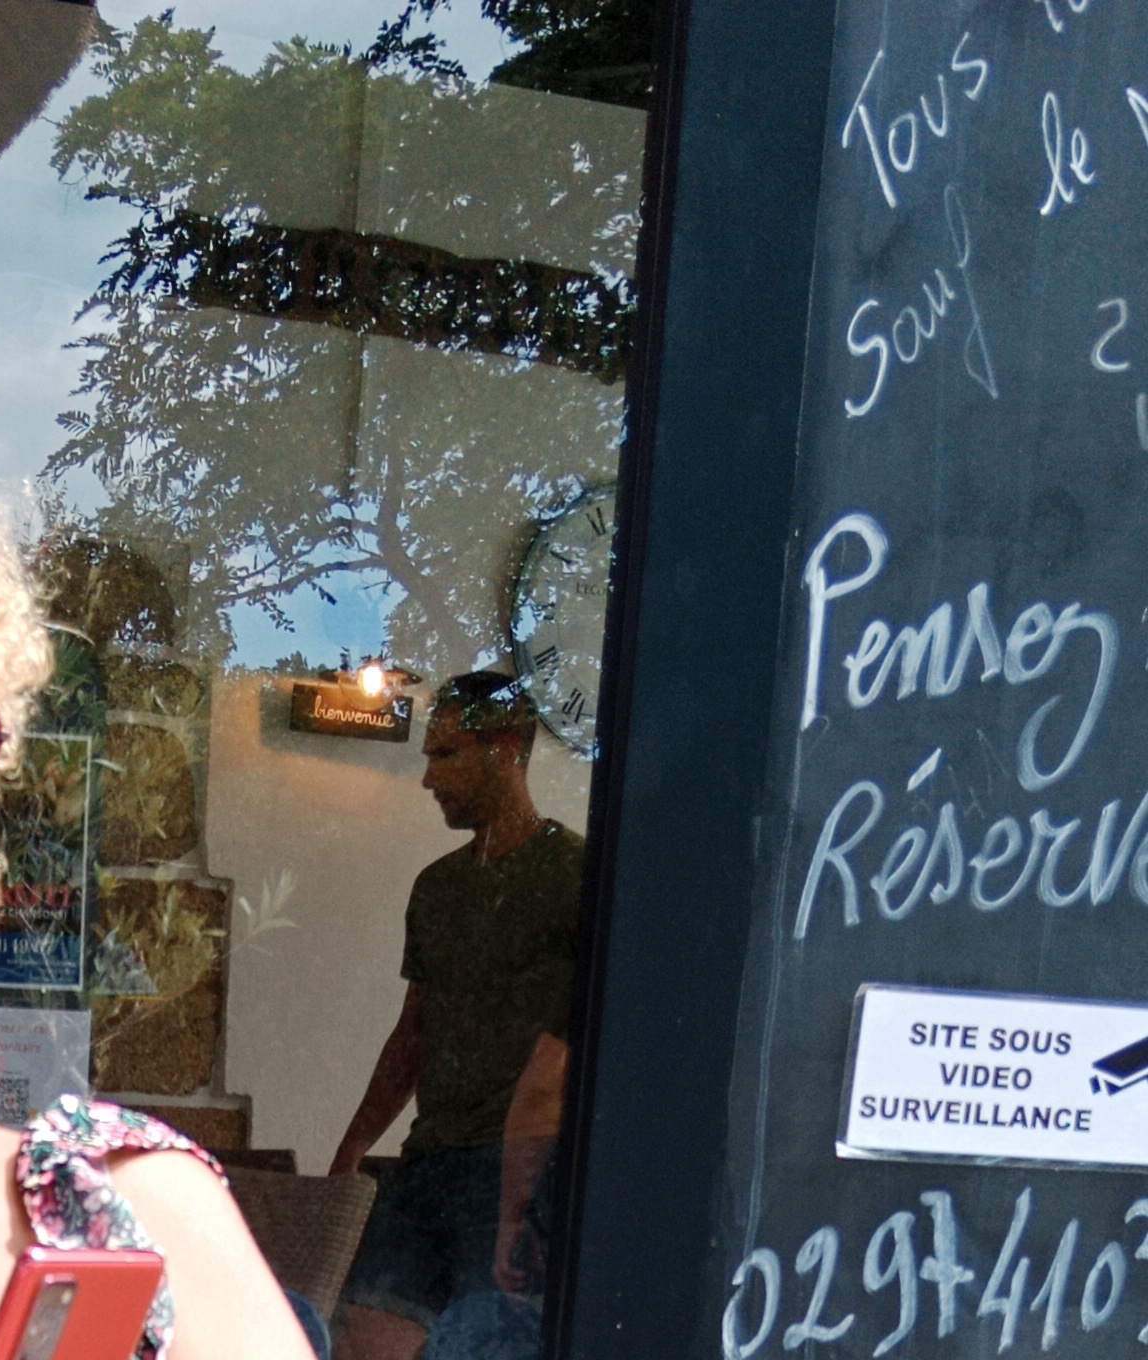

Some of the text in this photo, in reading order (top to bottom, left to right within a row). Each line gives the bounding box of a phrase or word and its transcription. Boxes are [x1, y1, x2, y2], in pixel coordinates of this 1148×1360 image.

[841, 31, 988, 209] Tous
[309, 693, 396, 729] bienvenue
[909, 1022, 1073, 1056] SITE SOUS
[940, 1062, 1033, 1091] VIDEO
[858, 1096, 1093, 1133] SURVEILLANCE
